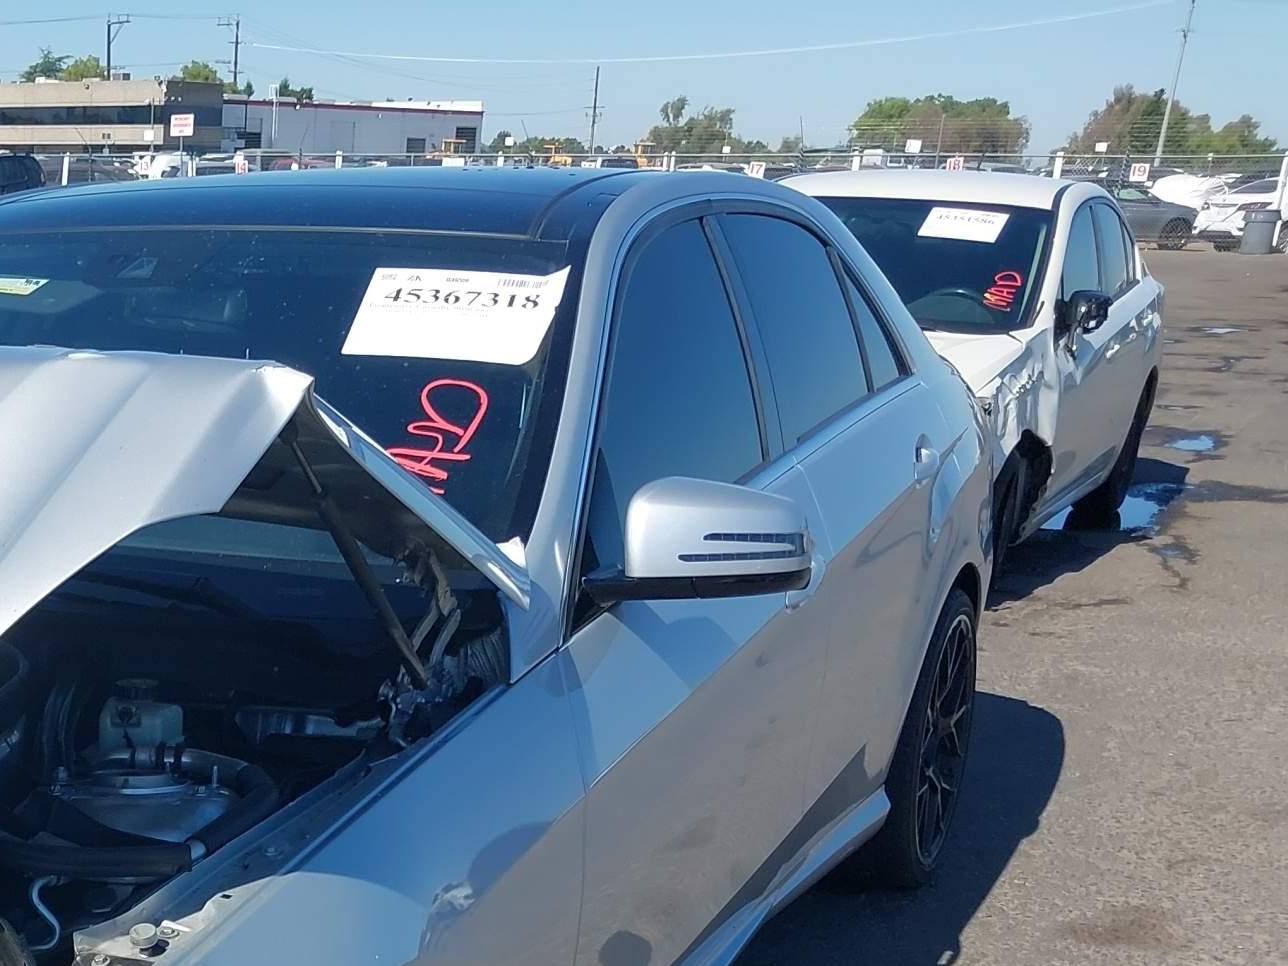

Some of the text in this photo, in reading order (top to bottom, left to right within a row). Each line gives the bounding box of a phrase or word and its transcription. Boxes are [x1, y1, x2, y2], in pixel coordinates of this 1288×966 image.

[140, 161, 149, 171] 13
[750, 164, 763, 175] 17
[948, 159, 961, 171] 18
[1132, 165, 1146, 176] 19
[384, 287, 541, 310] 45367318
